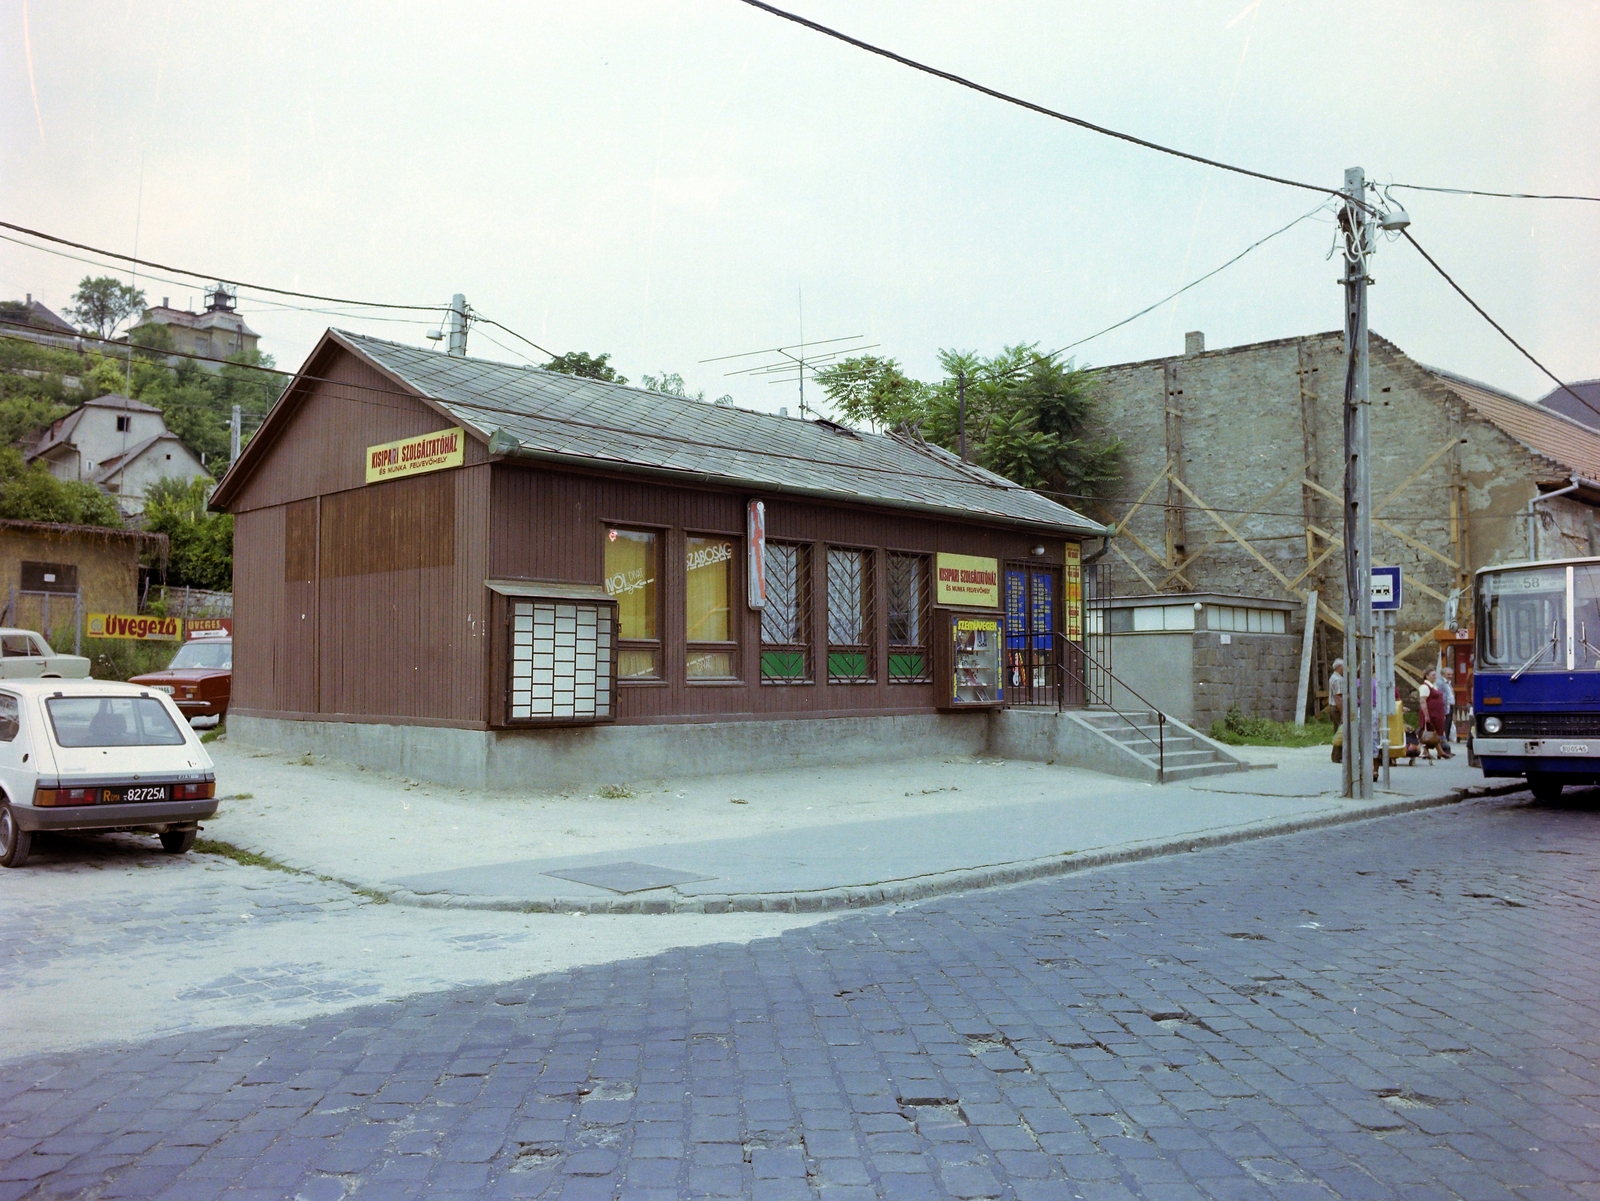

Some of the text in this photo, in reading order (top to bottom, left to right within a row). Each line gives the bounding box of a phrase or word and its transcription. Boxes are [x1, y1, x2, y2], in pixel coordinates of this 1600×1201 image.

[371, 433, 458, 469] KISIPARI SZOLGÁLTATÓHÁZ
[379, 467, 386, 475] ÉS
[388, 465, 407, 474] MUNKA
[1523, 577, 1541, 589] 58
